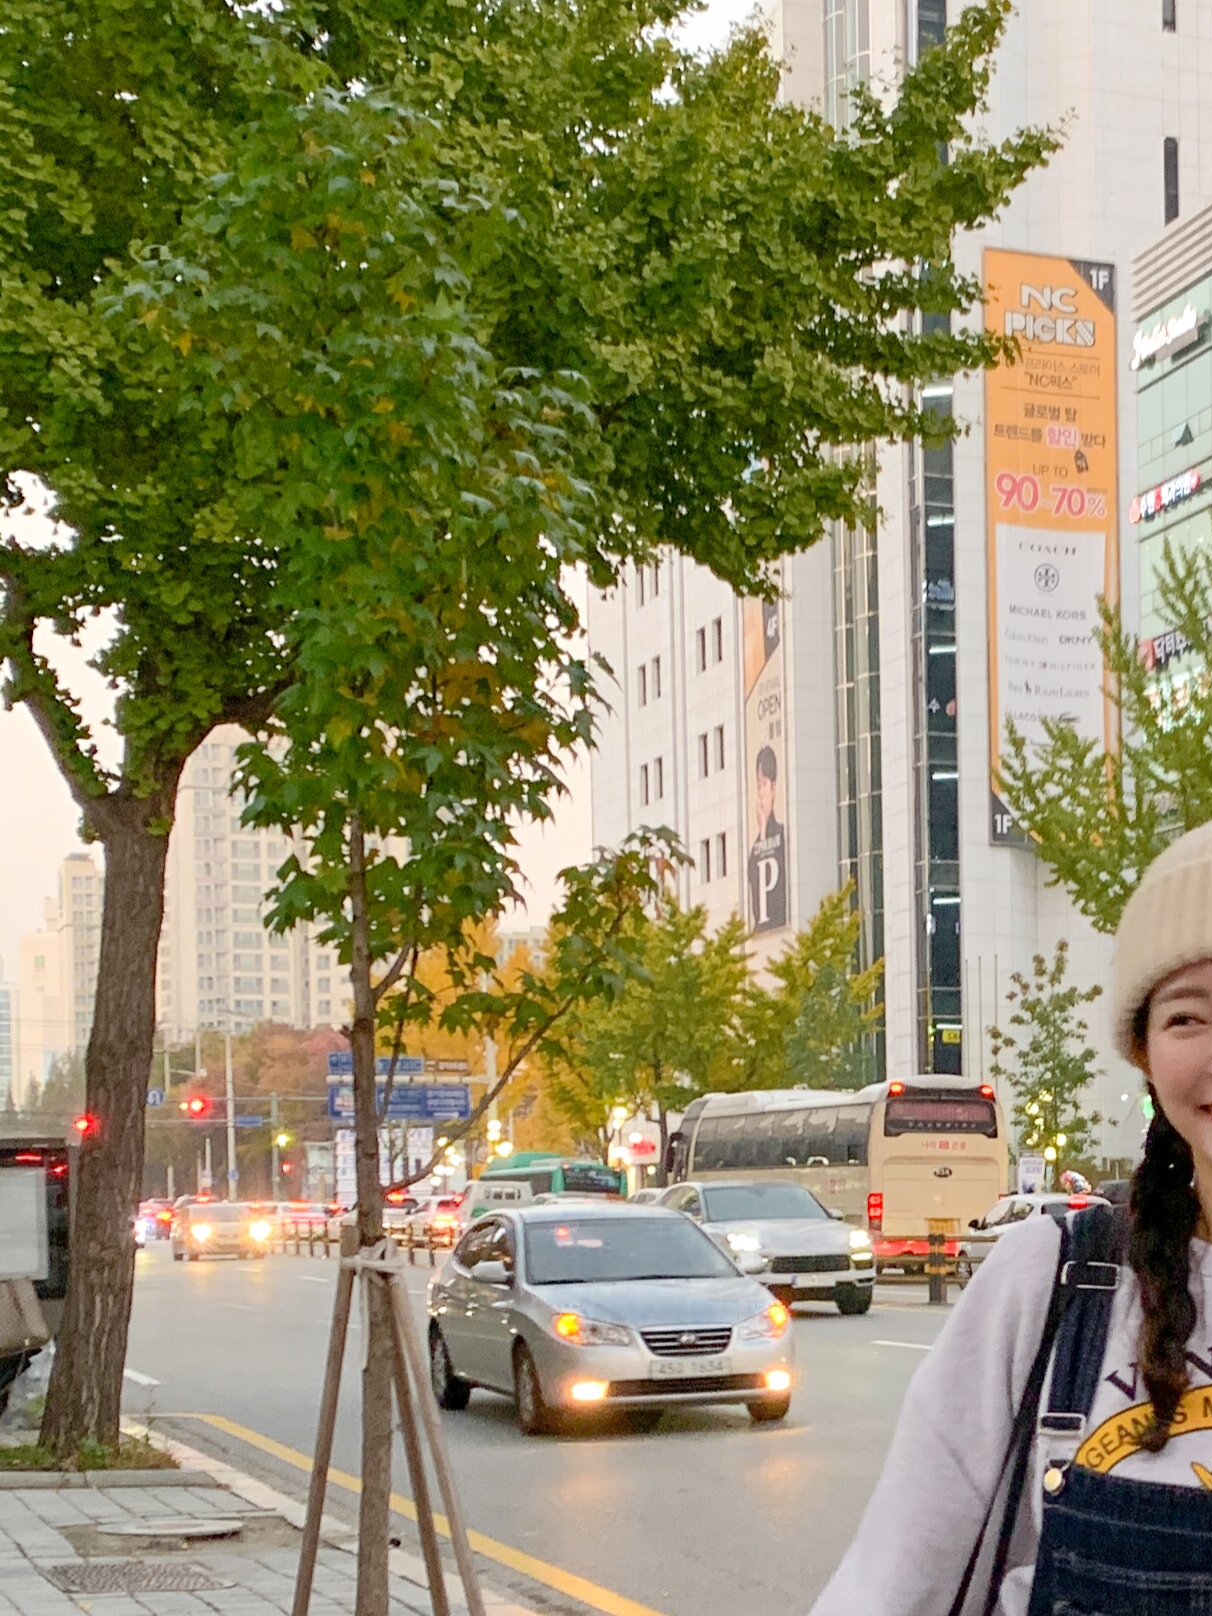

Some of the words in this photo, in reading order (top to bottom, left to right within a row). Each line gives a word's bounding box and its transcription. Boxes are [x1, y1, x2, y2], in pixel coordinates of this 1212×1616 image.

[1090, 268, 1110, 291] 1F
[1021, 283, 1078, 313] NC
[1004, 310, 1095, 348] PICKS
[1023, 402, 1060, 422] 글로벌
[994, 423, 1042, 444] 트렌드를
[1047, 426, 1078, 449] 할인
[1080, 432, 1107, 449] 받다
[1032, 463, 1050, 477] UP
[1053, 466, 1069, 479] TO
[1019, 542, 1077, 556] COACH
[1009, 604, 1052, 620] MICHAEL
[1056, 609, 1087, 621] KORS
[1059, 634, 1094, 645] DKNY
[994, 813, 1013, 835] 1F
